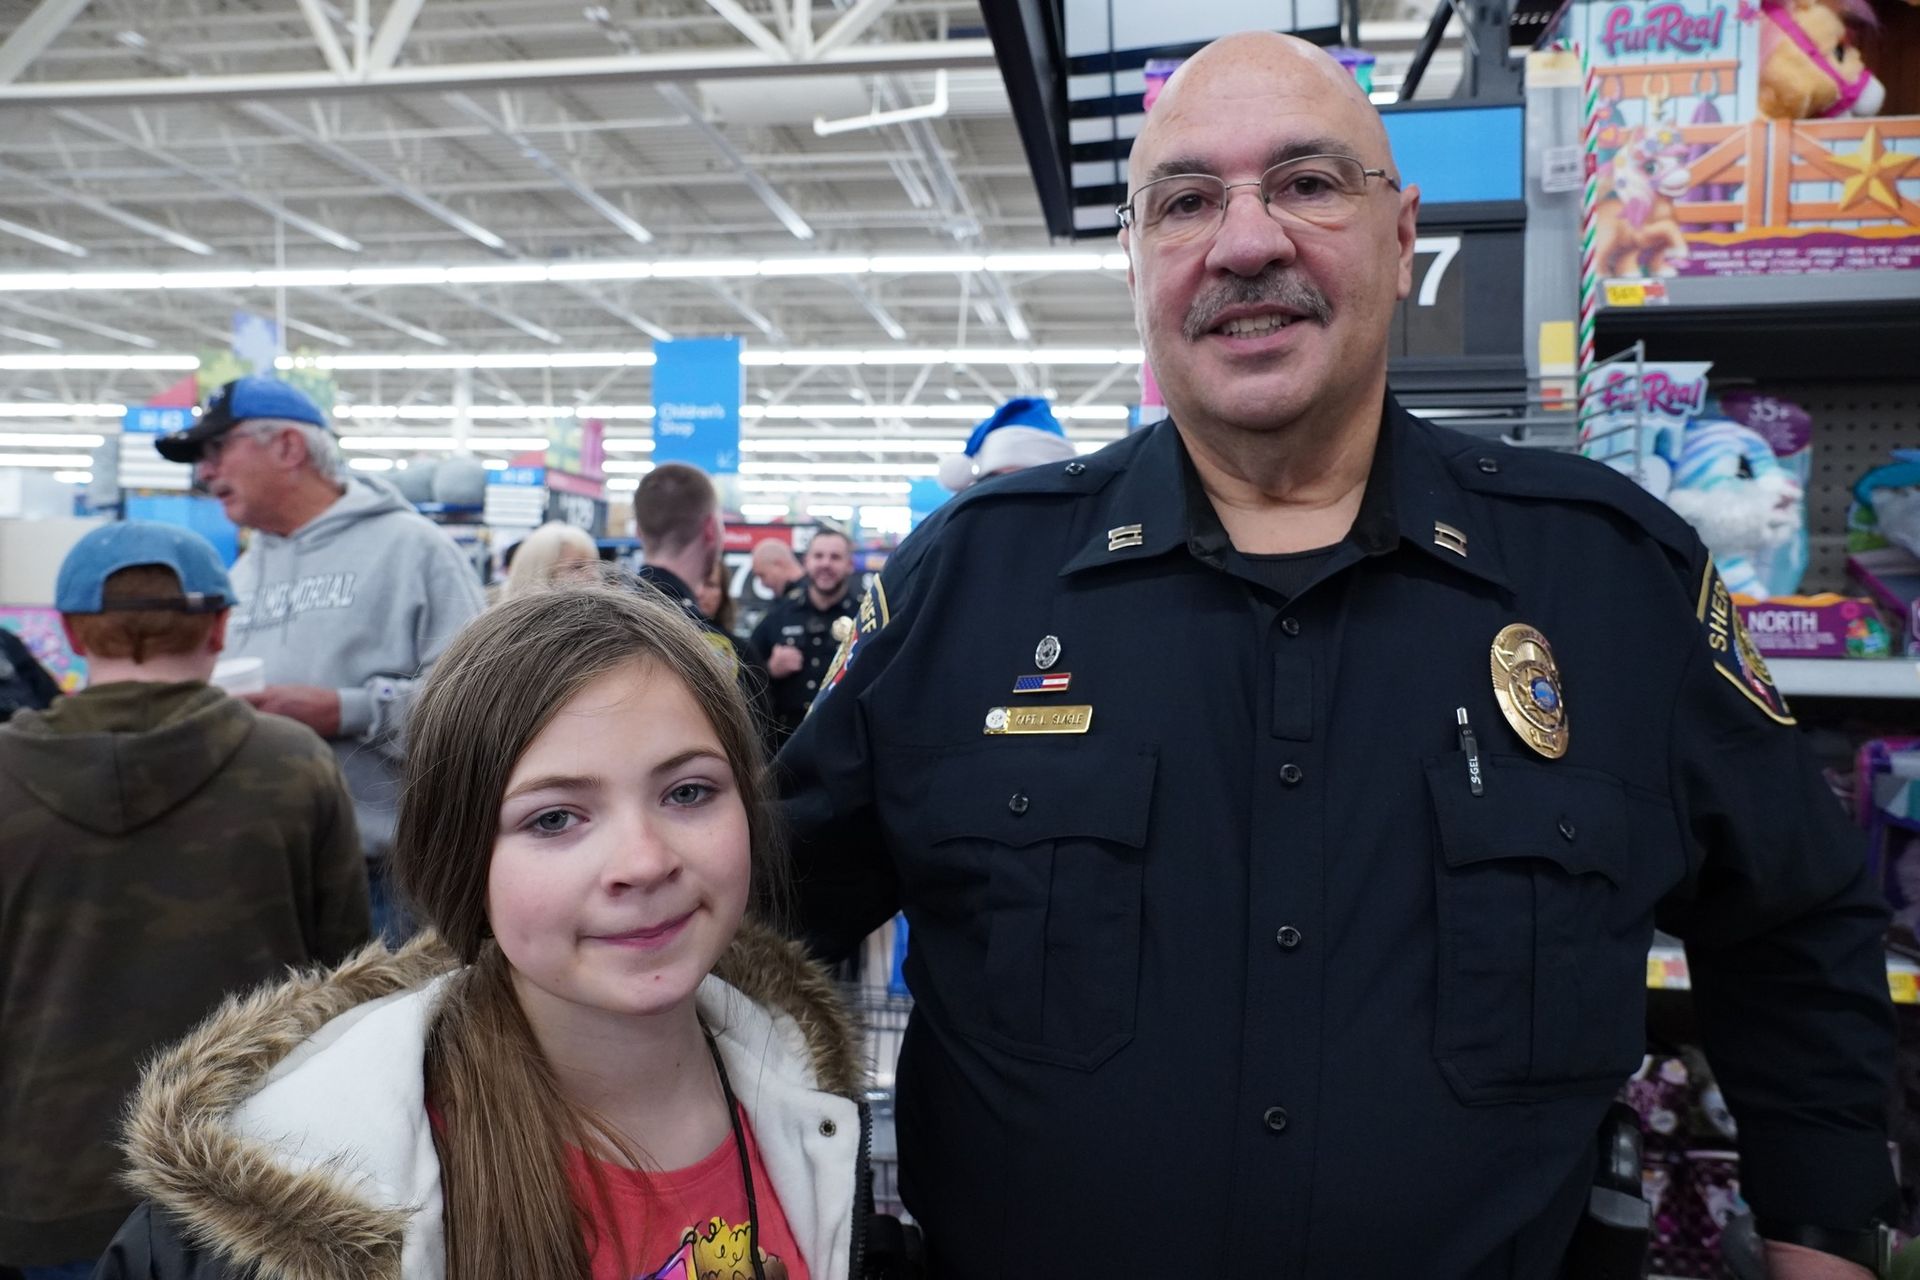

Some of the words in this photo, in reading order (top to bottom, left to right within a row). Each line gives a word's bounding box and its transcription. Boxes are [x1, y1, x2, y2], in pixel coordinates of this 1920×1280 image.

[1414, 236, 1461, 306] 7
[658, 402, 726, 420] Children's
[659, 421, 695, 438] Shop
[1747, 610, 1818, 633] NORTH
